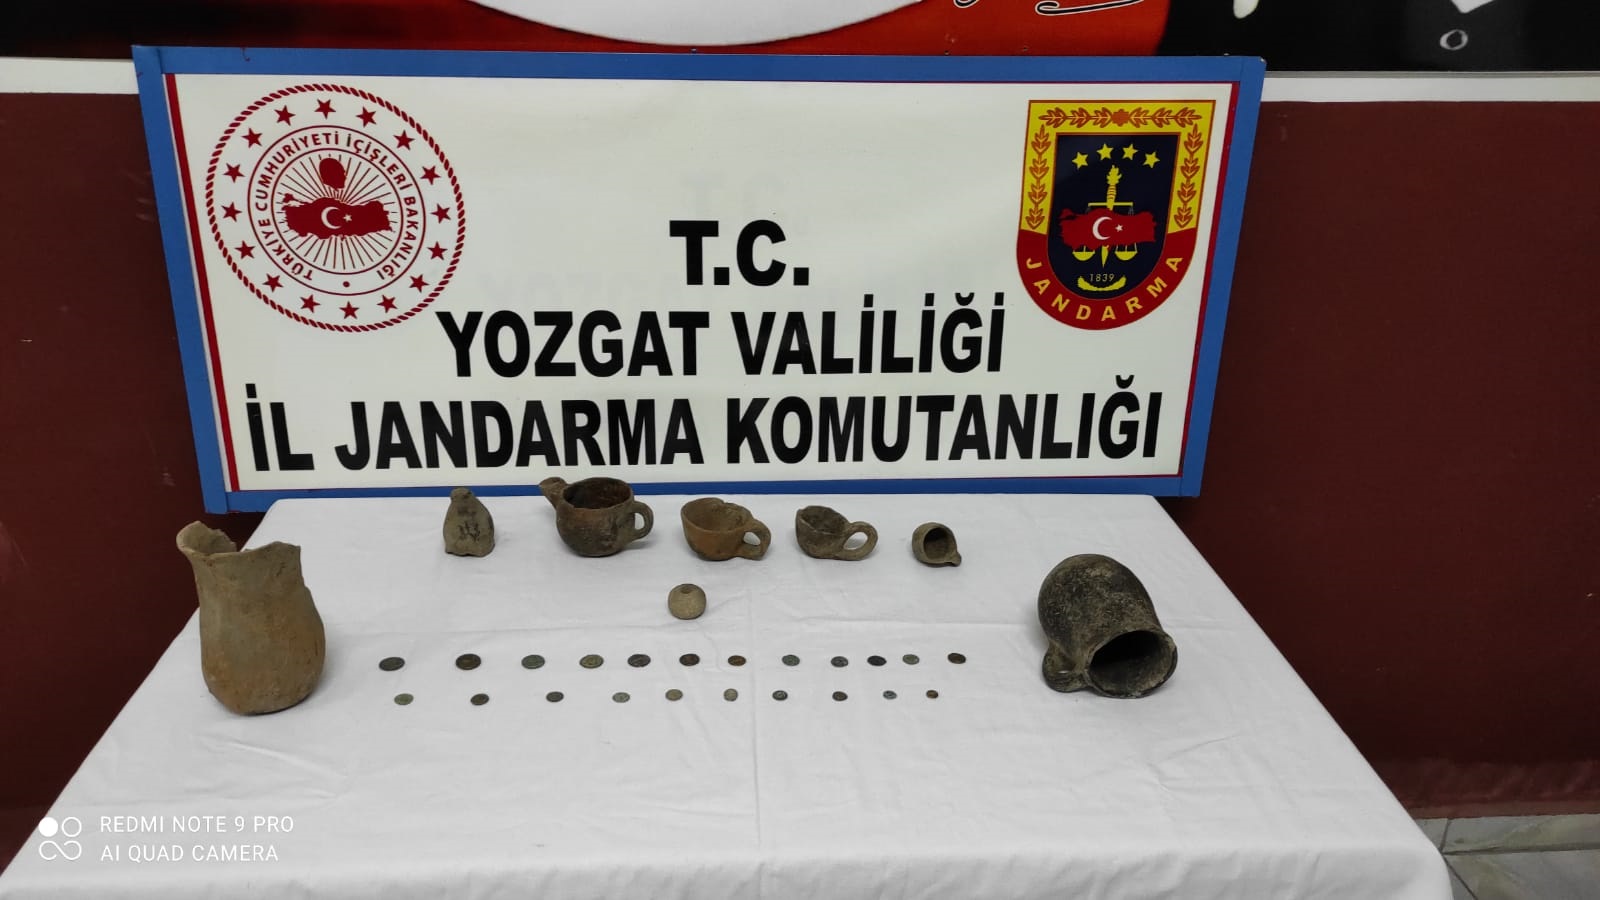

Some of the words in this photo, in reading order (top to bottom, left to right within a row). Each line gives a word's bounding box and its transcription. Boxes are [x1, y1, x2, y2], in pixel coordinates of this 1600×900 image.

[255, 130, 339, 211] CUMHURİYETİ
[346, 133, 411, 191] İÇİŞLERİ
[258, 218, 313, 281] TÜRKİYE
[377, 196, 418, 280] BAKANLIĞI
[670, 220, 809, 286] T.C.
[1026, 255, 1183, 321] JANDARMA
[1089, 273, 1114, 282] 1839
[436, 310, 709, 377] YOZGAT
[731, 292, 1004, 375] VALİLİĞİ
[246, 383, 314, 471] İL
[335, 398, 704, 470] JANDARMA
[727, 375, 1163, 463] KOMUTANLIĞI
